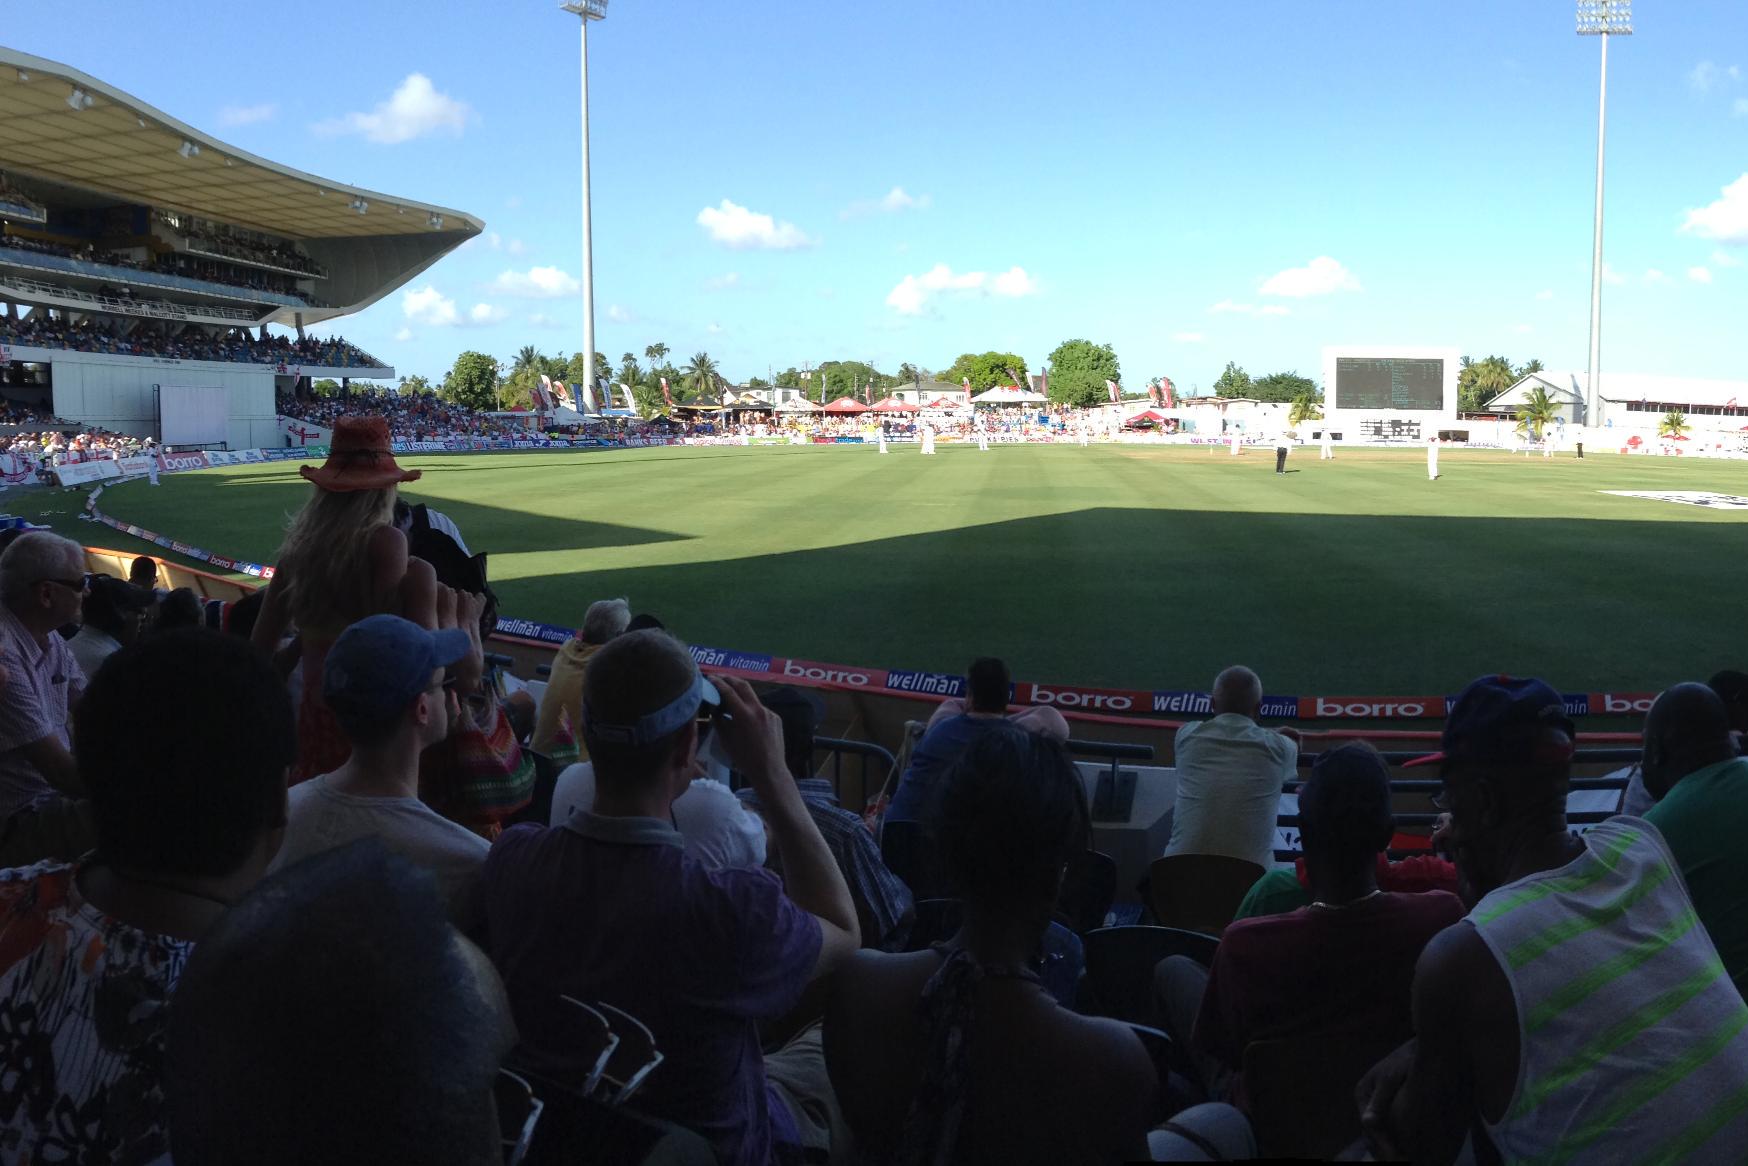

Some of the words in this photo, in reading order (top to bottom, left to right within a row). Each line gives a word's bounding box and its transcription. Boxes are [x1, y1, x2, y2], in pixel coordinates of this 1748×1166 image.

[407, 440, 446, 450] LISTERINE
[163, 455, 203, 471] borro
[210, 555, 231, 569] borro
[496, 617, 542, 637] wellman
[689, 645, 726, 666] llman
[729, 656, 770, 672] vitamin
[784, 659, 870, 686] borro
[887, 671, 961, 695] wellman
[1030, 684, 1133, 710] borro
[1153, 693, 1214, 713] wellm
[1260, 702, 1297, 717] amin
[1316, 697, 1425, 718] borro
